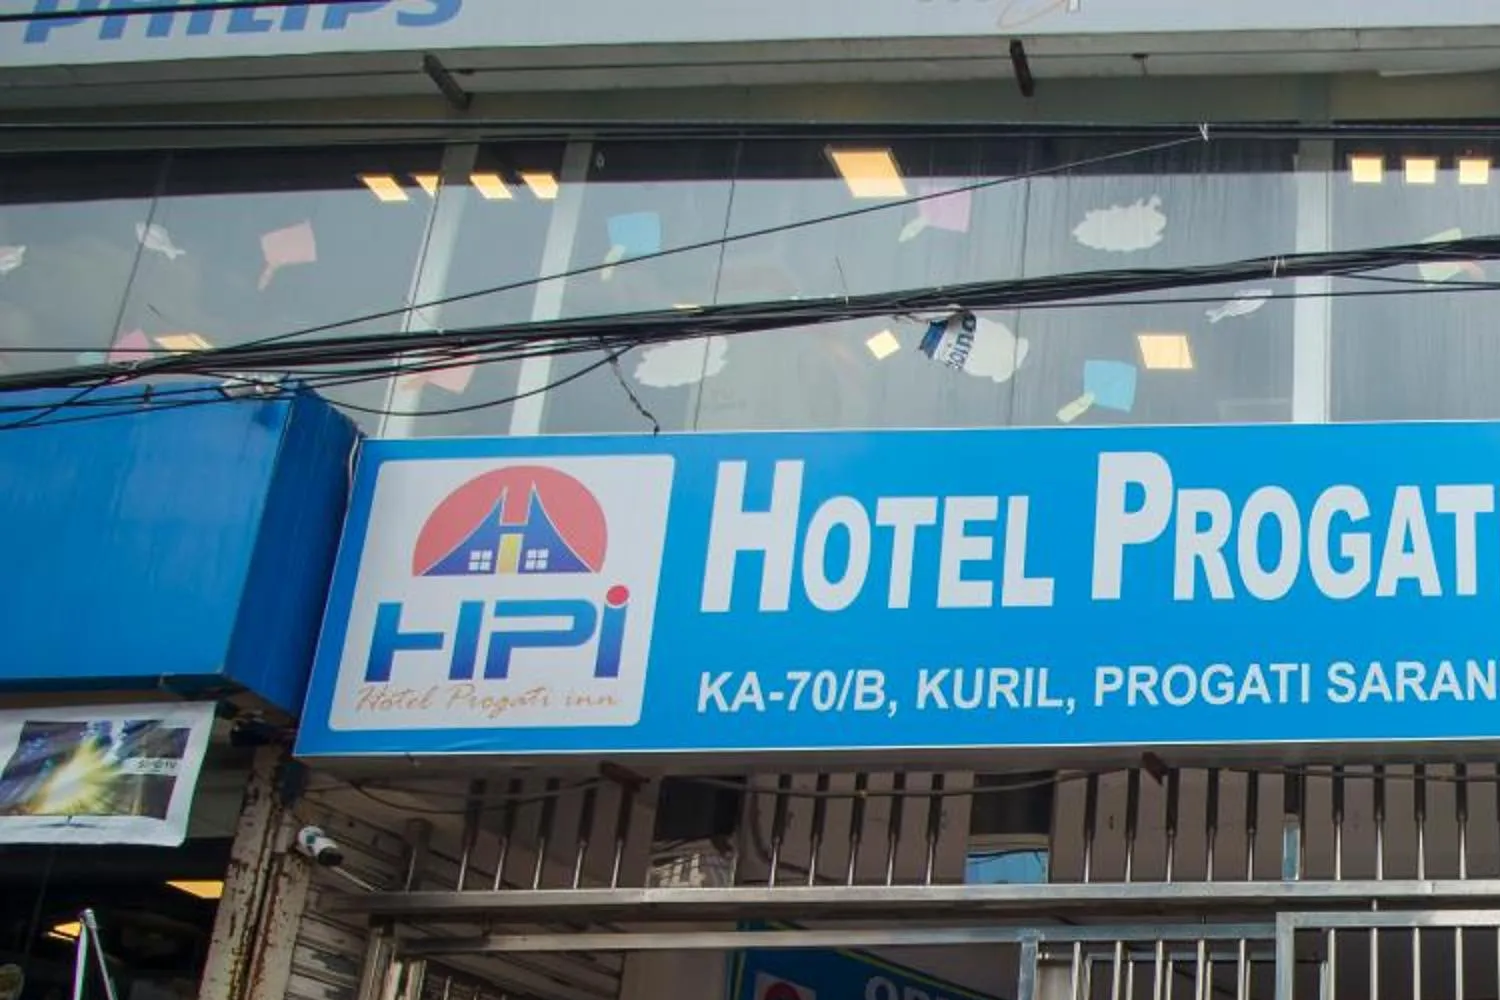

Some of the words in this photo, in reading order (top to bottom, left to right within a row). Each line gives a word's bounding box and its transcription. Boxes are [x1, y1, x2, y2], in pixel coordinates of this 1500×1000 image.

[700, 460, 1055, 613] HOTEL
[354, 683, 439, 713] Hotel
[697, 669, 898, 717] KA-70/B,
[915, 666, 1077, 715] KURIL,
[1094, 662, 1311, 706] PROGATI
